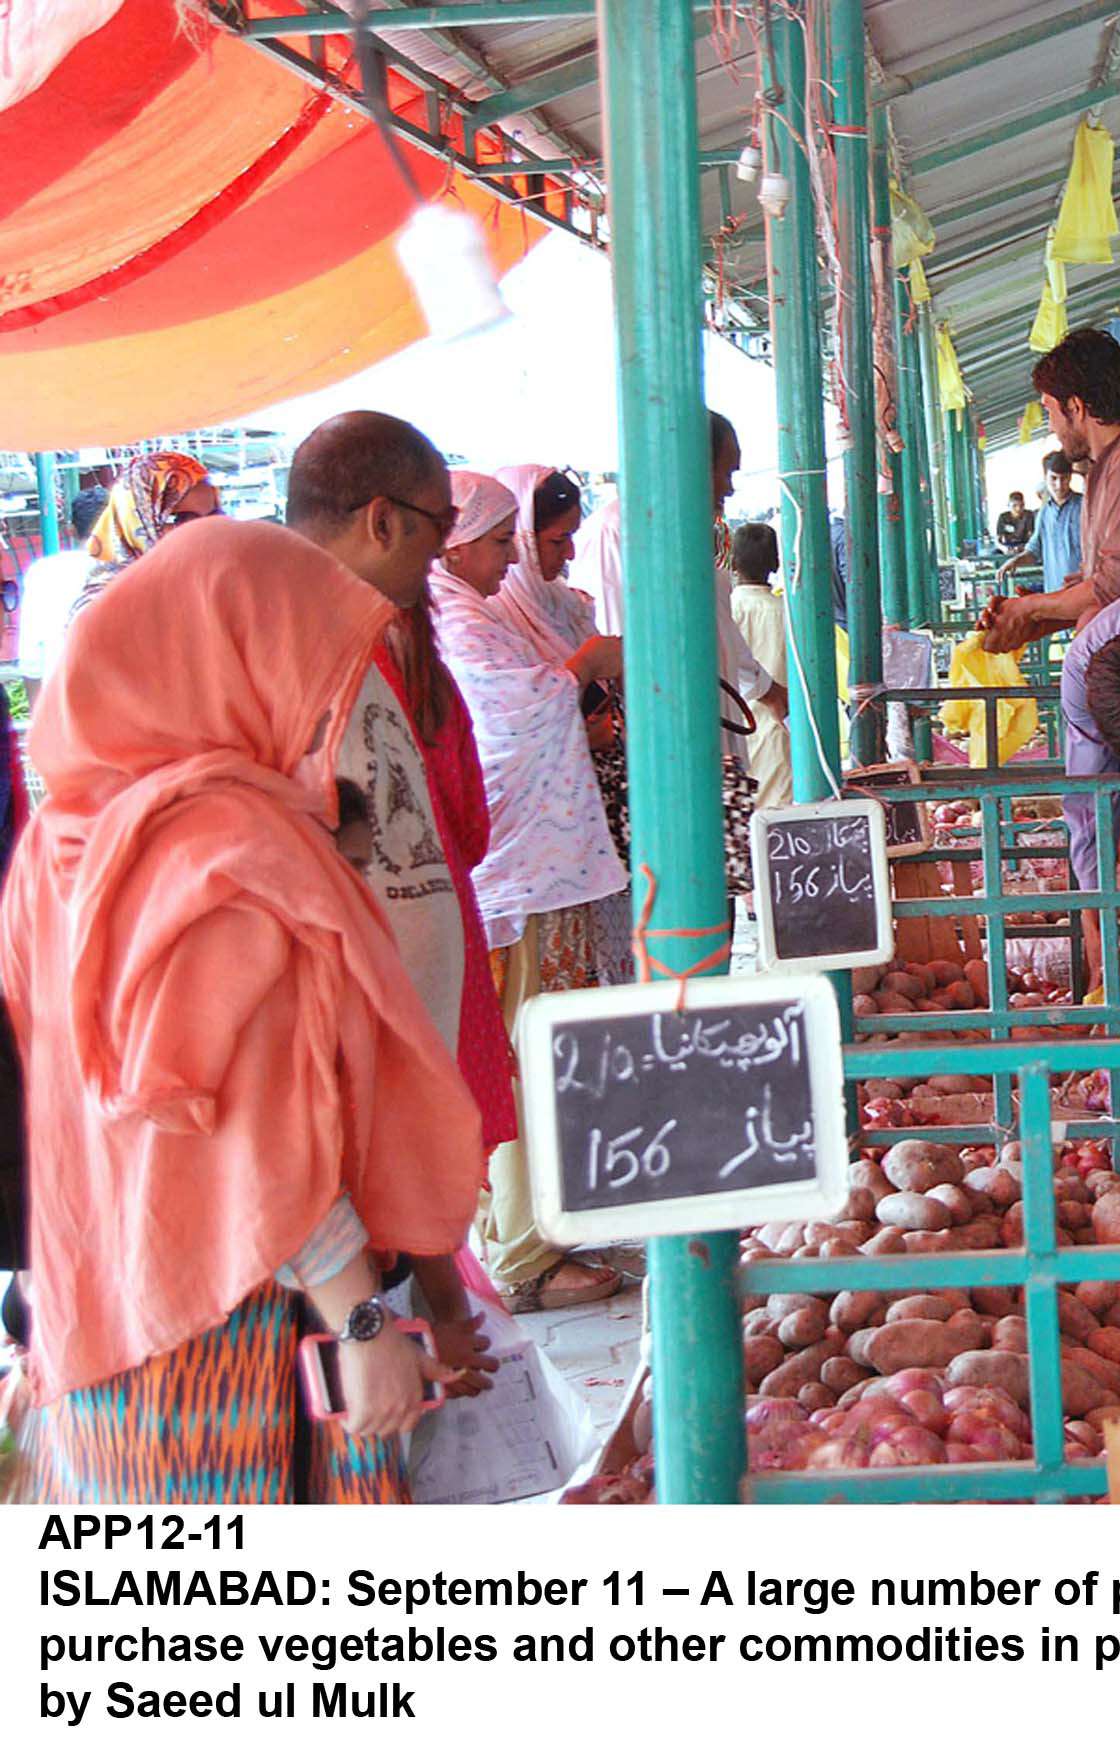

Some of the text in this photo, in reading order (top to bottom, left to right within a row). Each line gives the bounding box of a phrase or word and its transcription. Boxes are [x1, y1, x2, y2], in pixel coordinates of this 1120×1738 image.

[767, 829, 811, 860] 210
[774, 865, 820, 904] 156
[589, 1119, 677, 1191] 156
